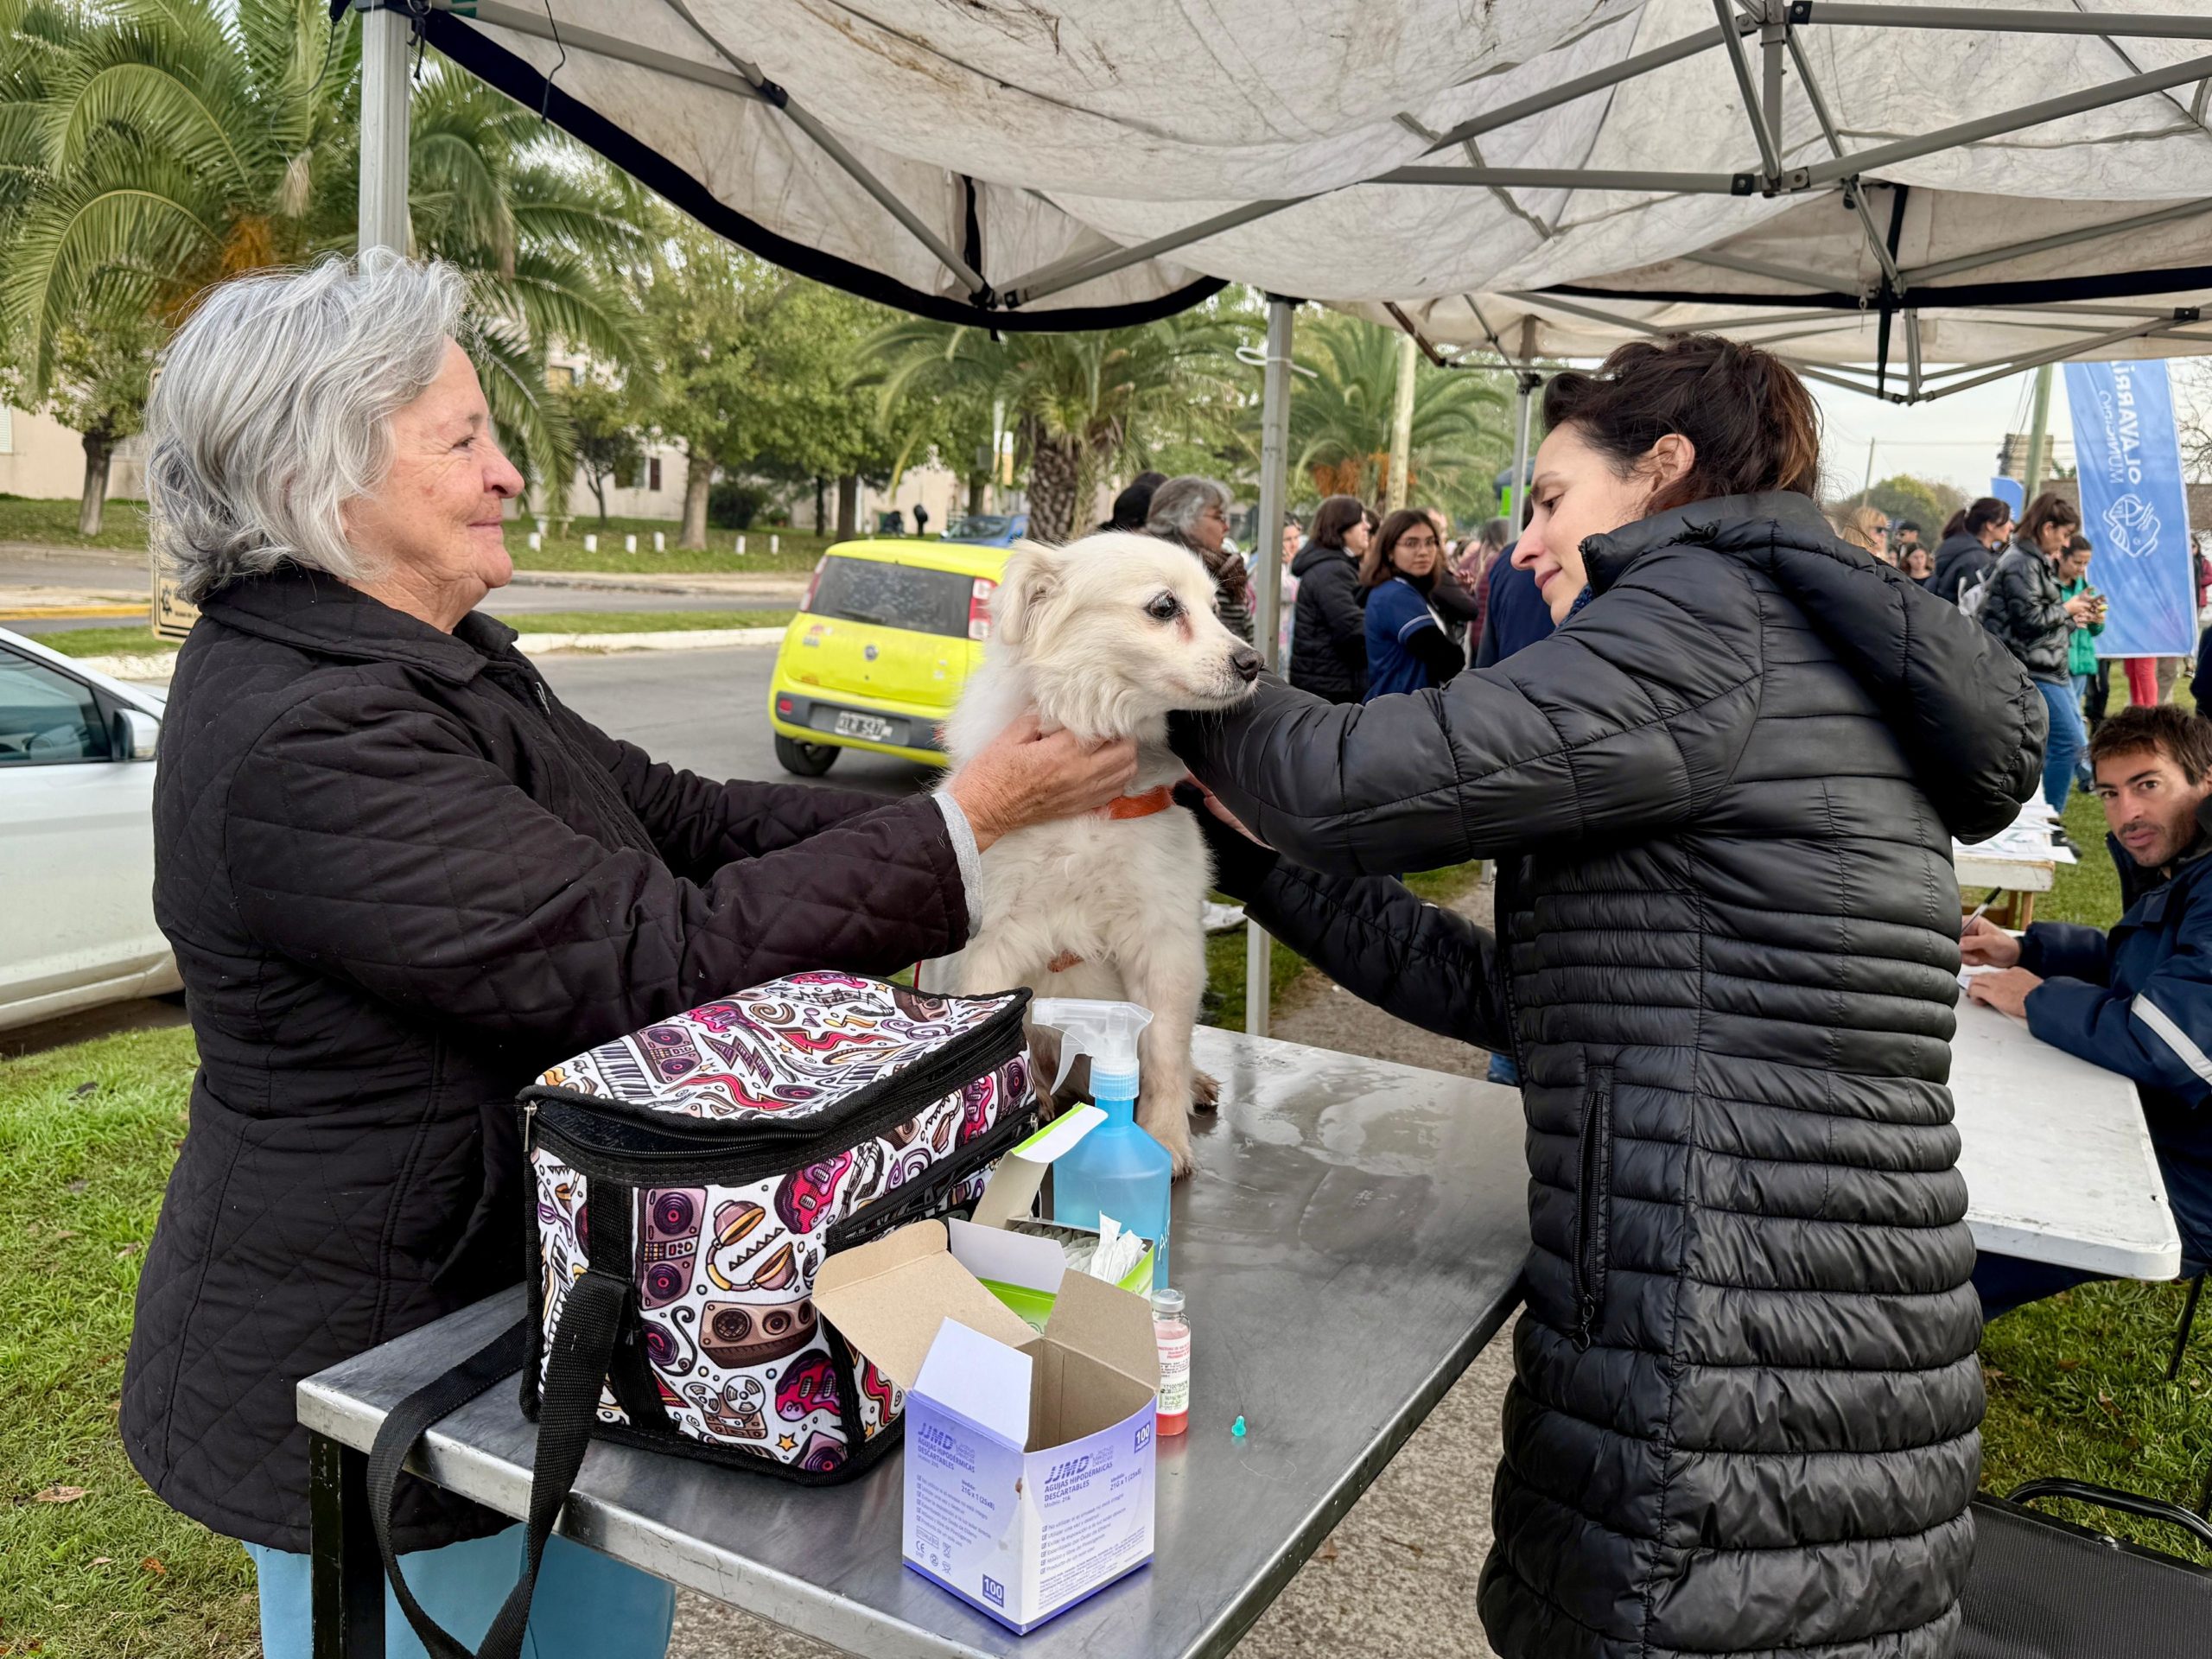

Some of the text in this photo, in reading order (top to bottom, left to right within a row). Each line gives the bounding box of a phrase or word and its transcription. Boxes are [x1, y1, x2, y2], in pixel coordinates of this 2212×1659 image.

[918, 1422, 954, 1450] JJMD
[918, 1437, 937, 1452] AGUJAS
[1135, 1424, 1150, 1444] 100
[918, 1445, 954, 1470] DESCARTABLES
[1045, 1455, 1090, 1484] JJMD
[1045, 1462, 1113, 1493] AGUJAS HIPODÉRMICAS
[961, 1485, 970, 1497] 21G
[1045, 1479, 1090, 1502] DESCARTABLES
[1109, 1482, 1120, 1491] 21G
[984, 1578, 1002, 1599] 100
